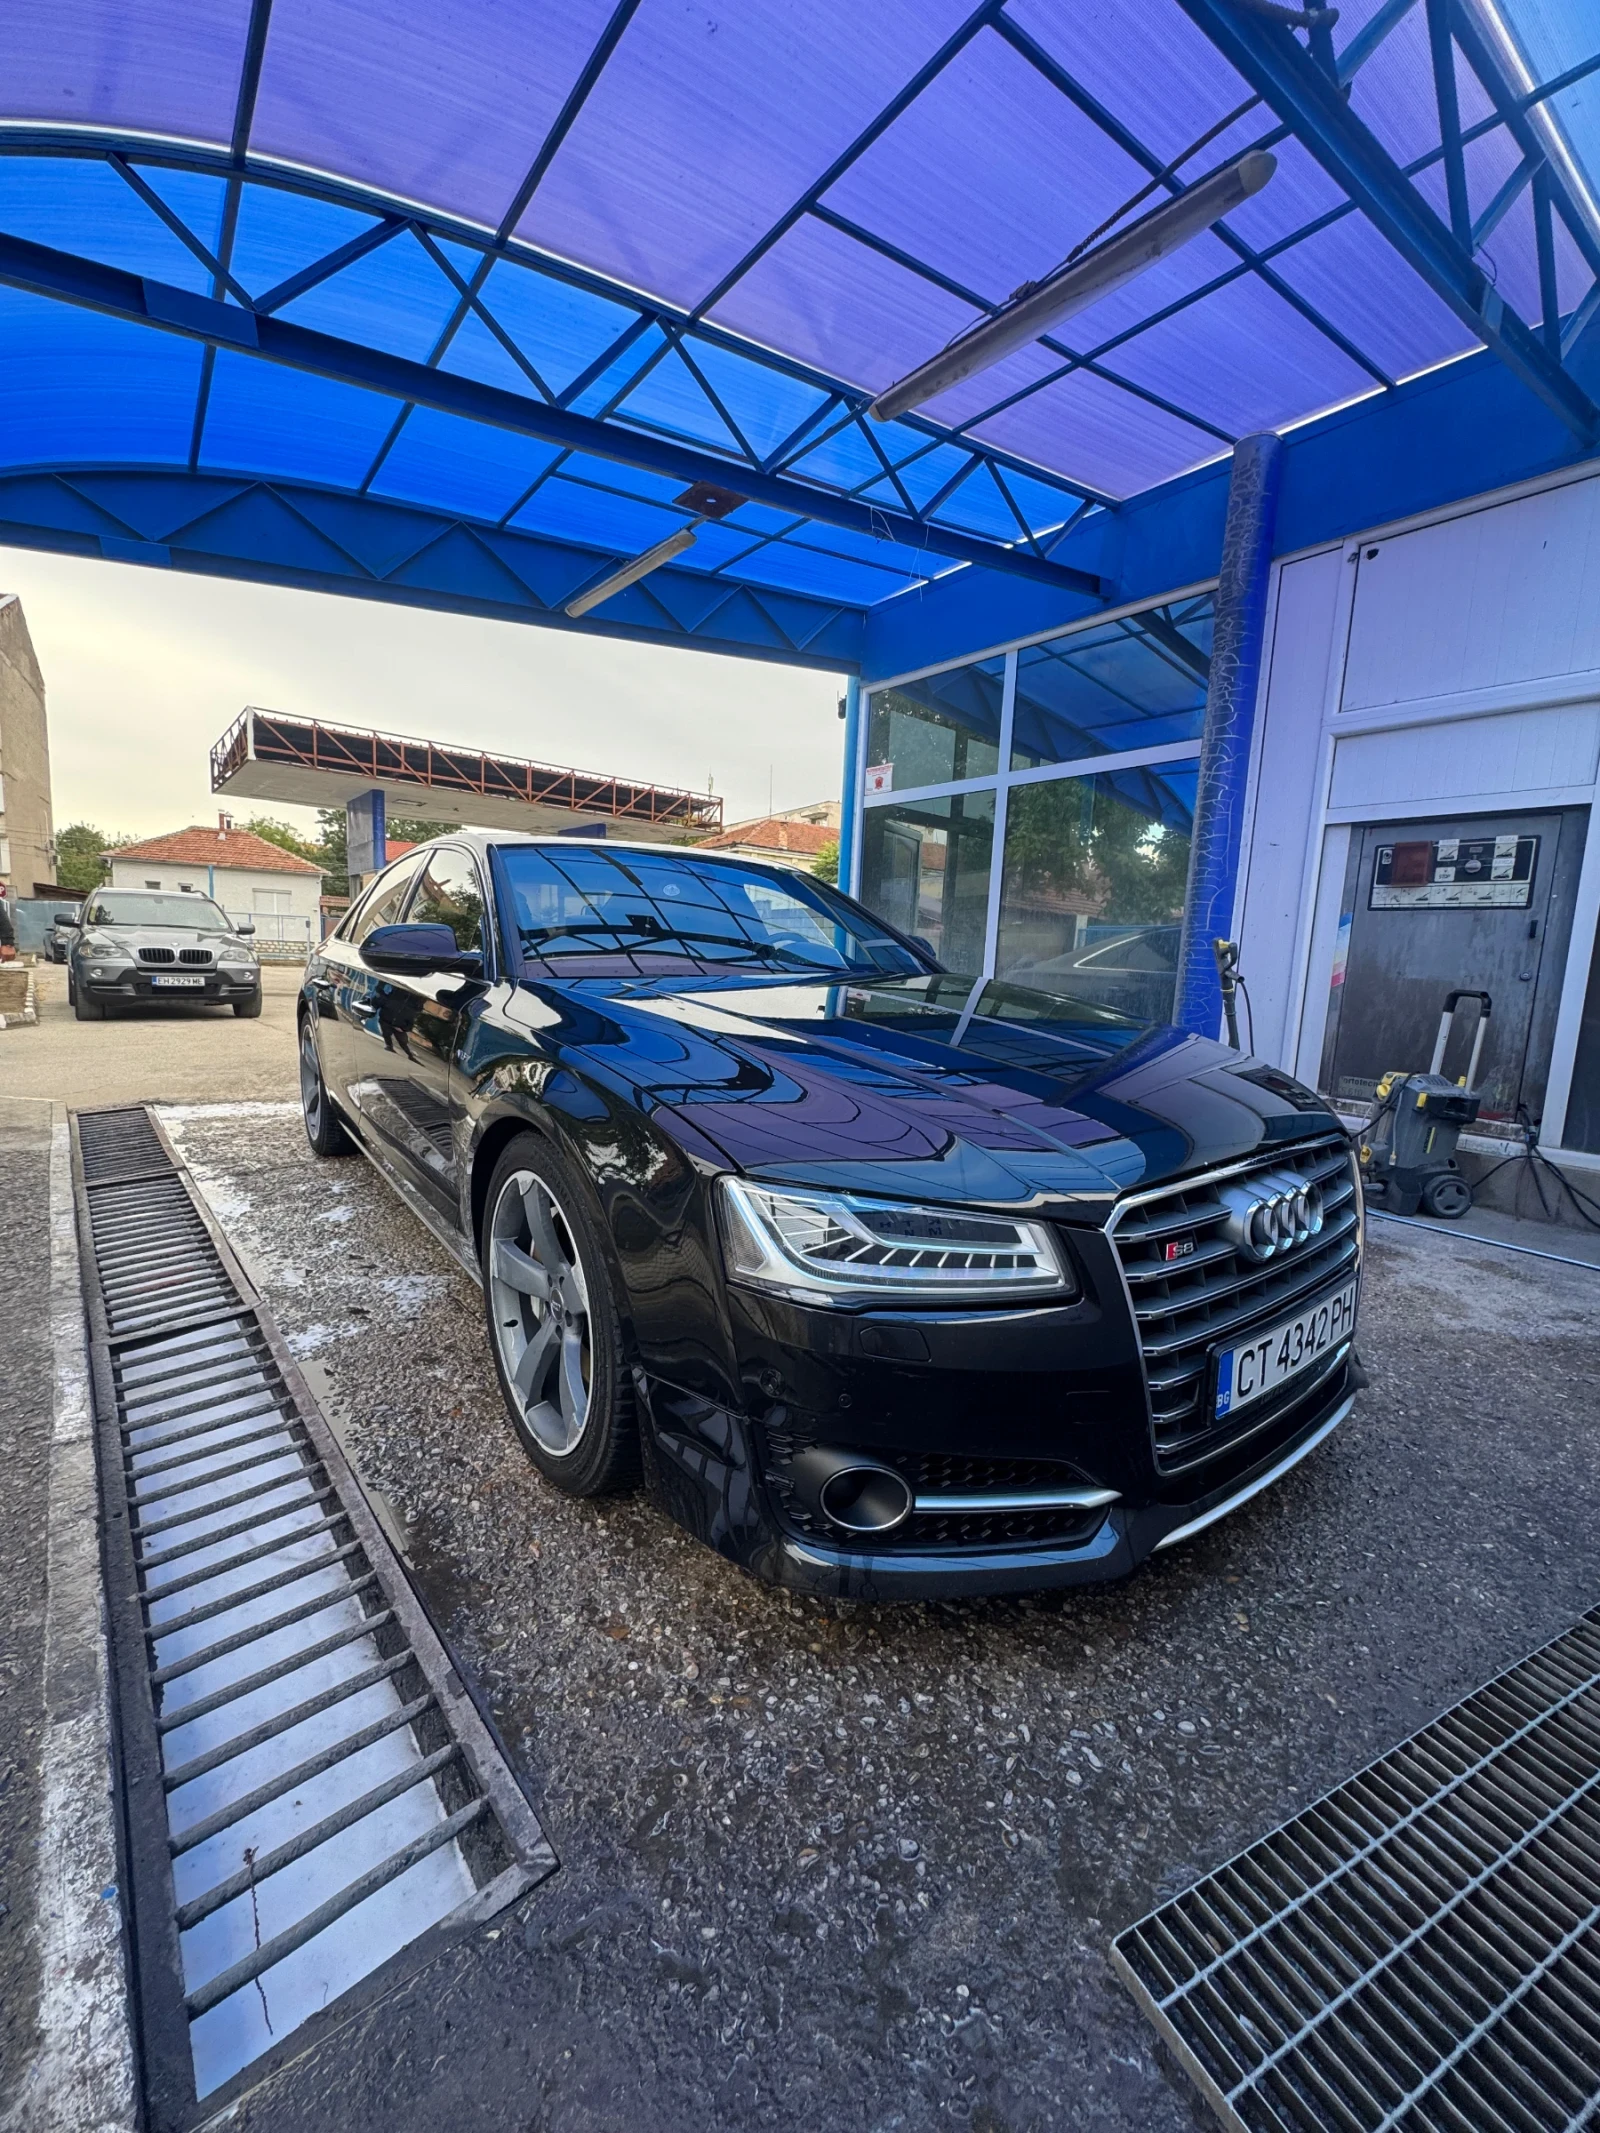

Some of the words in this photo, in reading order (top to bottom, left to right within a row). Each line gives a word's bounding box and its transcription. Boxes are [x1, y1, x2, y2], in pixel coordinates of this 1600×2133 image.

[1173, 1241, 1194, 1257] S8
[1237, 1338, 1273, 1398] CT
[1276, 1306, 1329, 1373] 4342
[1329, 1286, 1354, 1341] PH
[1216, 1391, 1230, 1409] BG
